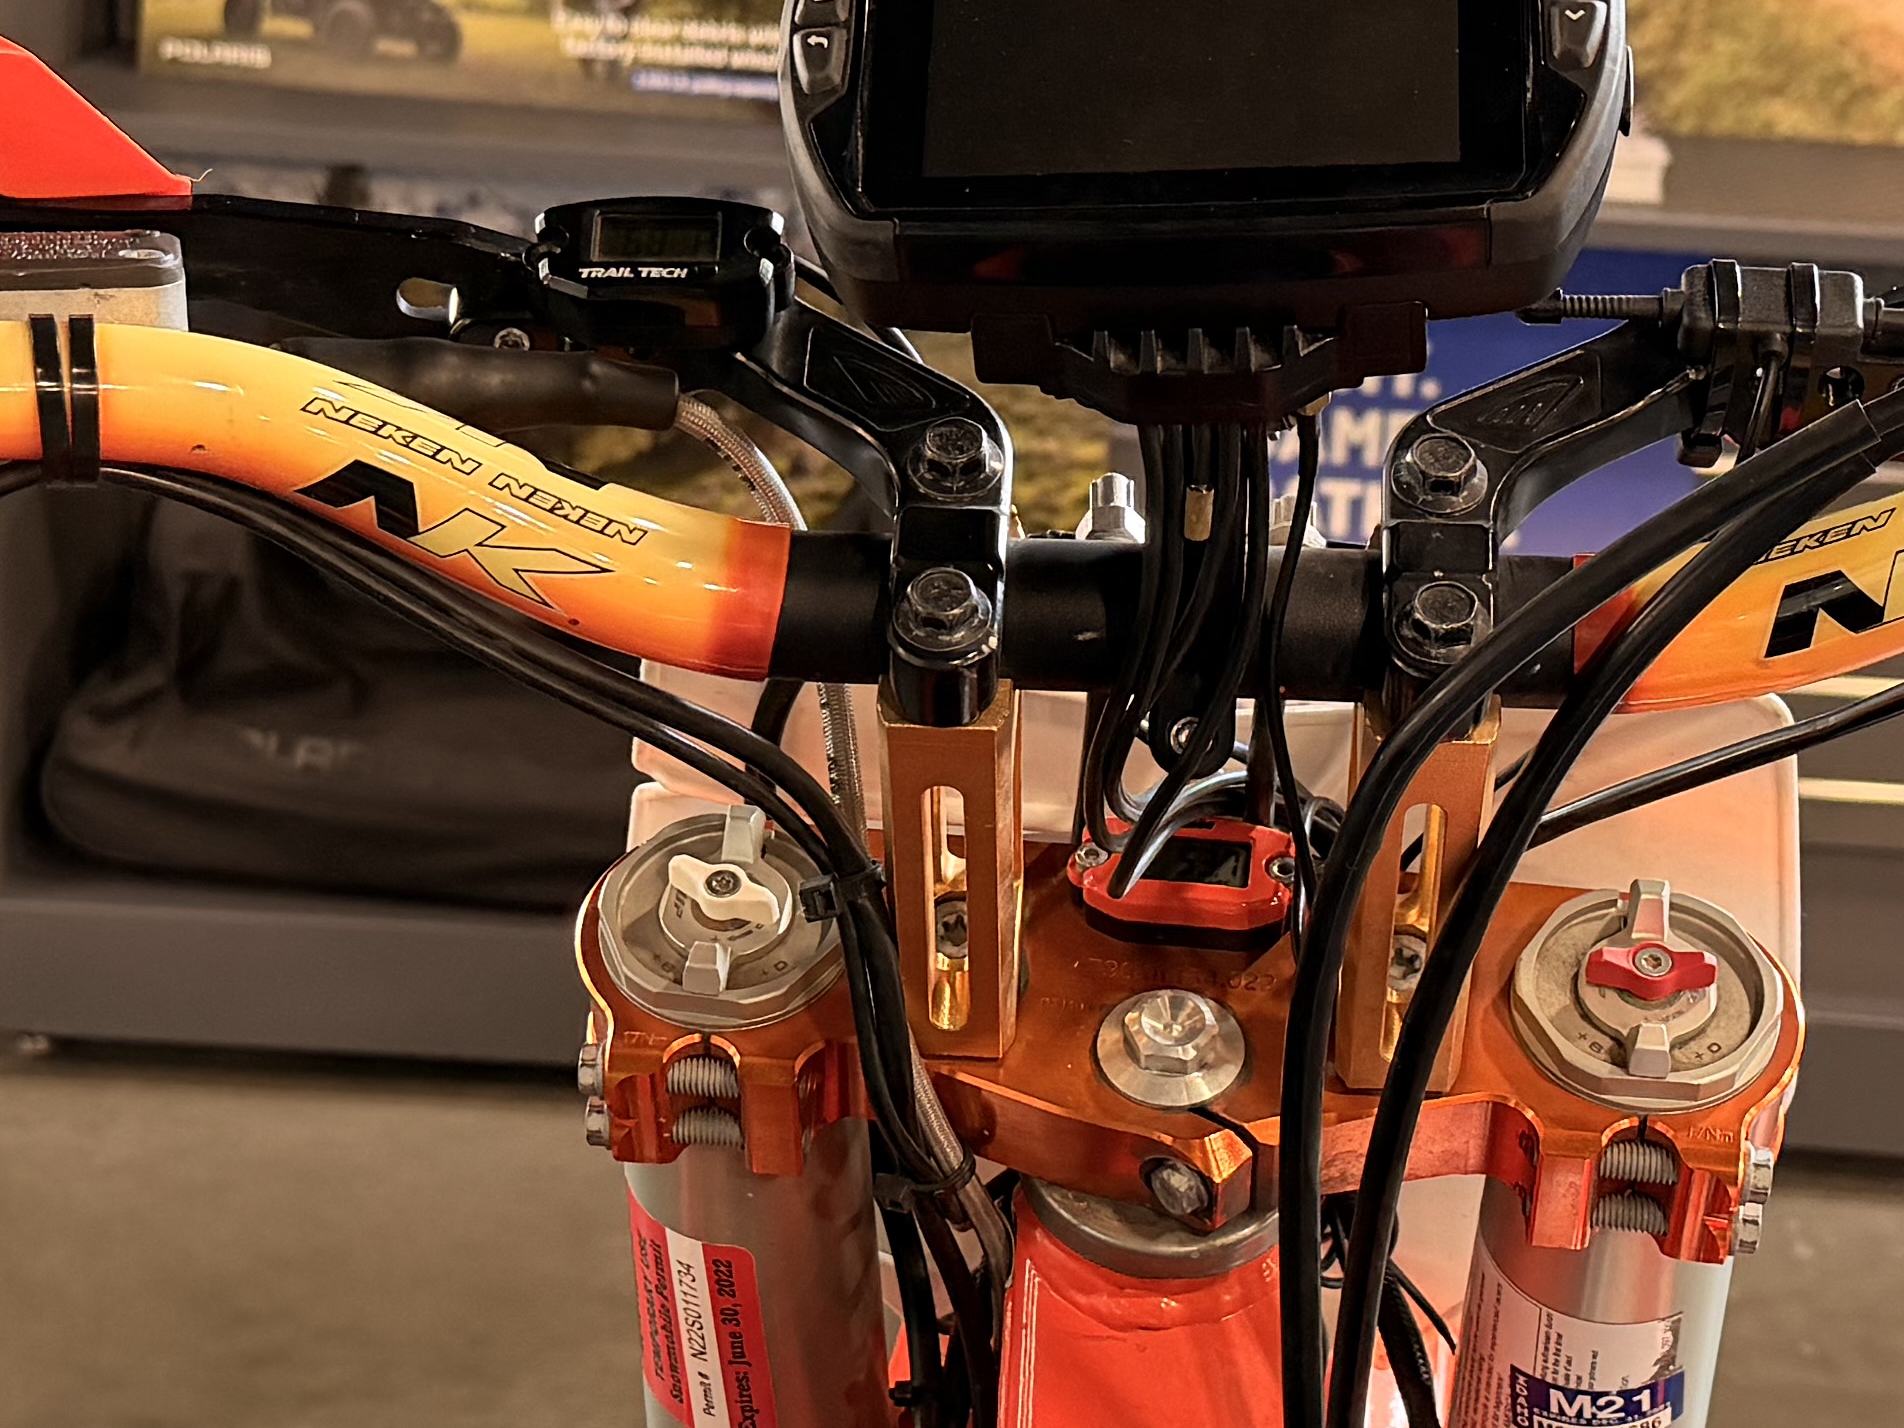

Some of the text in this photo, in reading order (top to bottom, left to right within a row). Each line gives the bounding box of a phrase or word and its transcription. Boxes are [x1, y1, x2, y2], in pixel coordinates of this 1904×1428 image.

[579, 267, 688, 279] TRAIL TECH
[300, 397, 649, 545] NEKEN NEKEN
[1754, 507, 1897, 565] EKEN
[712, 1259, 737, 1299] 2022
[650, 1239, 684, 1404] Snowmobile Permit
[677, 1259, 708, 1362] N22S011734
[721, 1303, 742, 1328] 30,
[728, 1331, 752, 1368] June
[700, 1381, 716, 1417] Permit
[1549, 1388, 1651, 1419] M21
